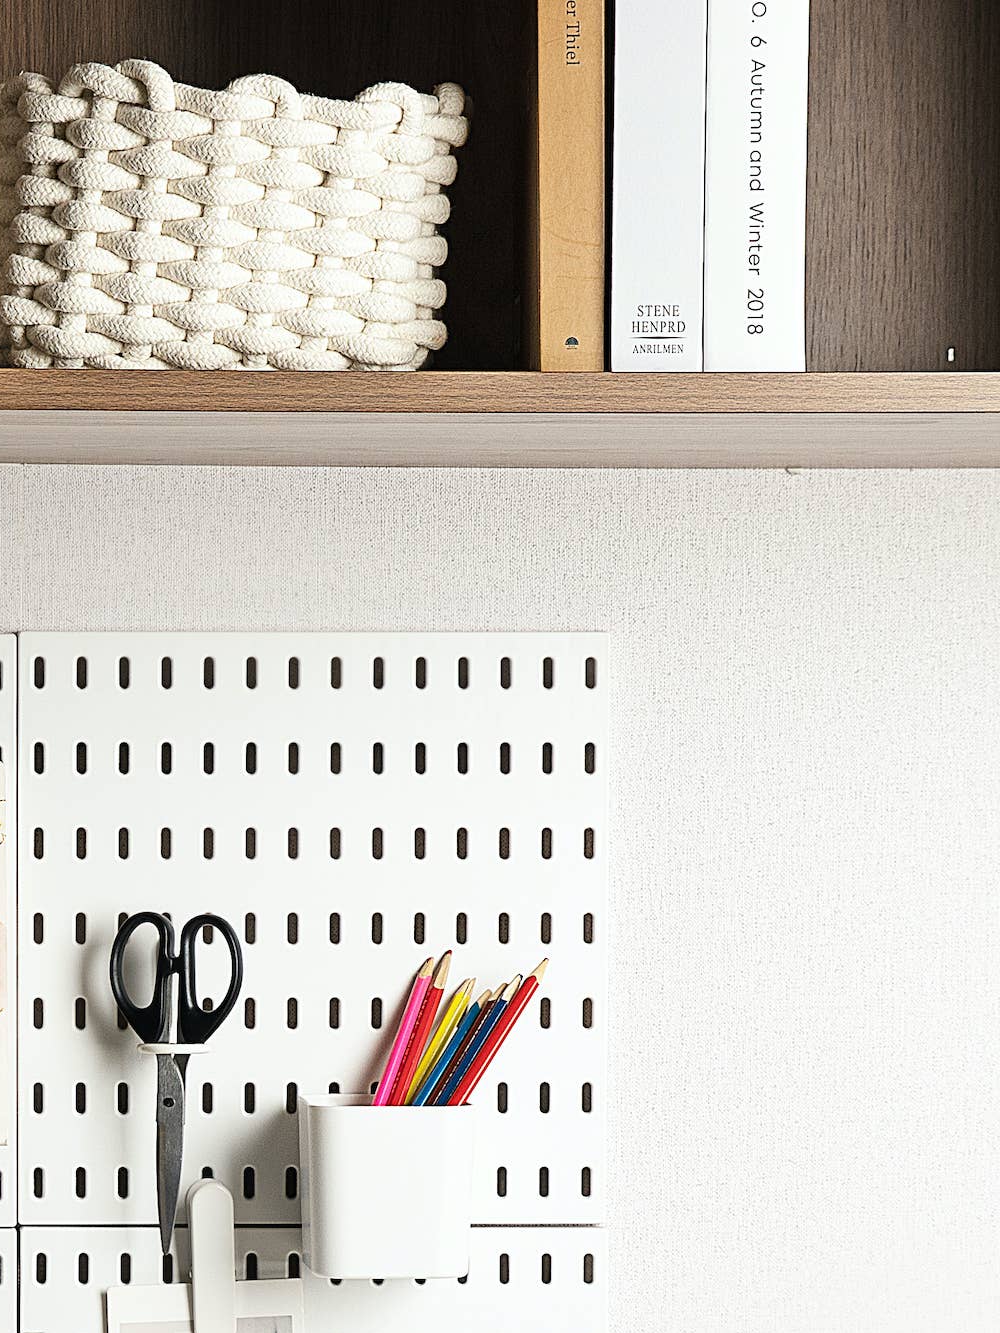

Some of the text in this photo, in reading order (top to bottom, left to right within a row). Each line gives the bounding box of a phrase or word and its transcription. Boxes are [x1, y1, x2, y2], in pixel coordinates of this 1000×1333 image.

[566, 20, 581, 66] Thiel
[751, 36, 767, 48] 6
[750, 59, 766, 143] Autumn
[749, 150, 765, 191] and
[748, 202, 765, 276] Winter
[632, 321, 686, 333] HENPRD
[637, 305, 680, 318] STENE
[747, 288, 764, 336] 2018
[632, 344, 684, 354] ANRILMEN
